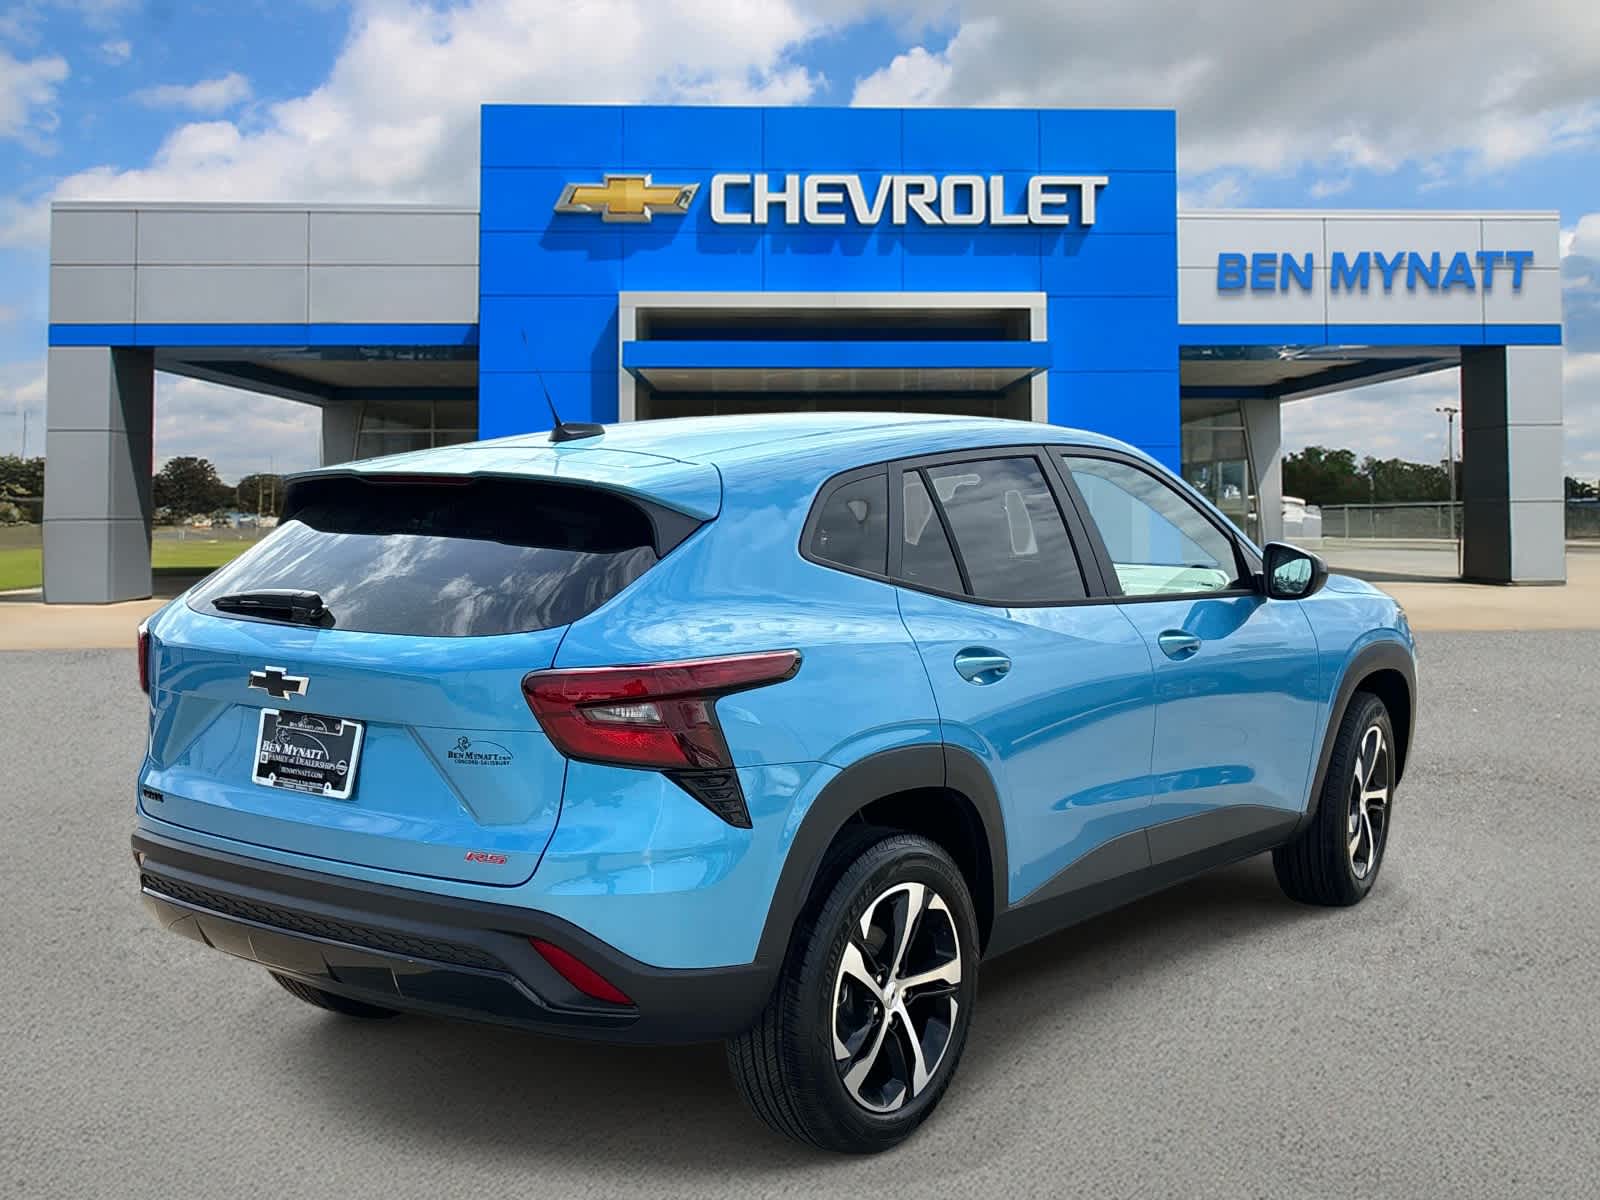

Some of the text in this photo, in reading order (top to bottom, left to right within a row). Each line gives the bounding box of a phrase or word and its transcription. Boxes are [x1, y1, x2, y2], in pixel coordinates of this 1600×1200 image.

[710, 173, 1109, 225] CHEVROLET
[1216, 250, 1534, 291] BEN MYNATT
[262, 740, 323, 760] BEN MYNATT
[296, 756, 336, 771] DEALERSHIPS
[465, 851, 506, 865] RS
